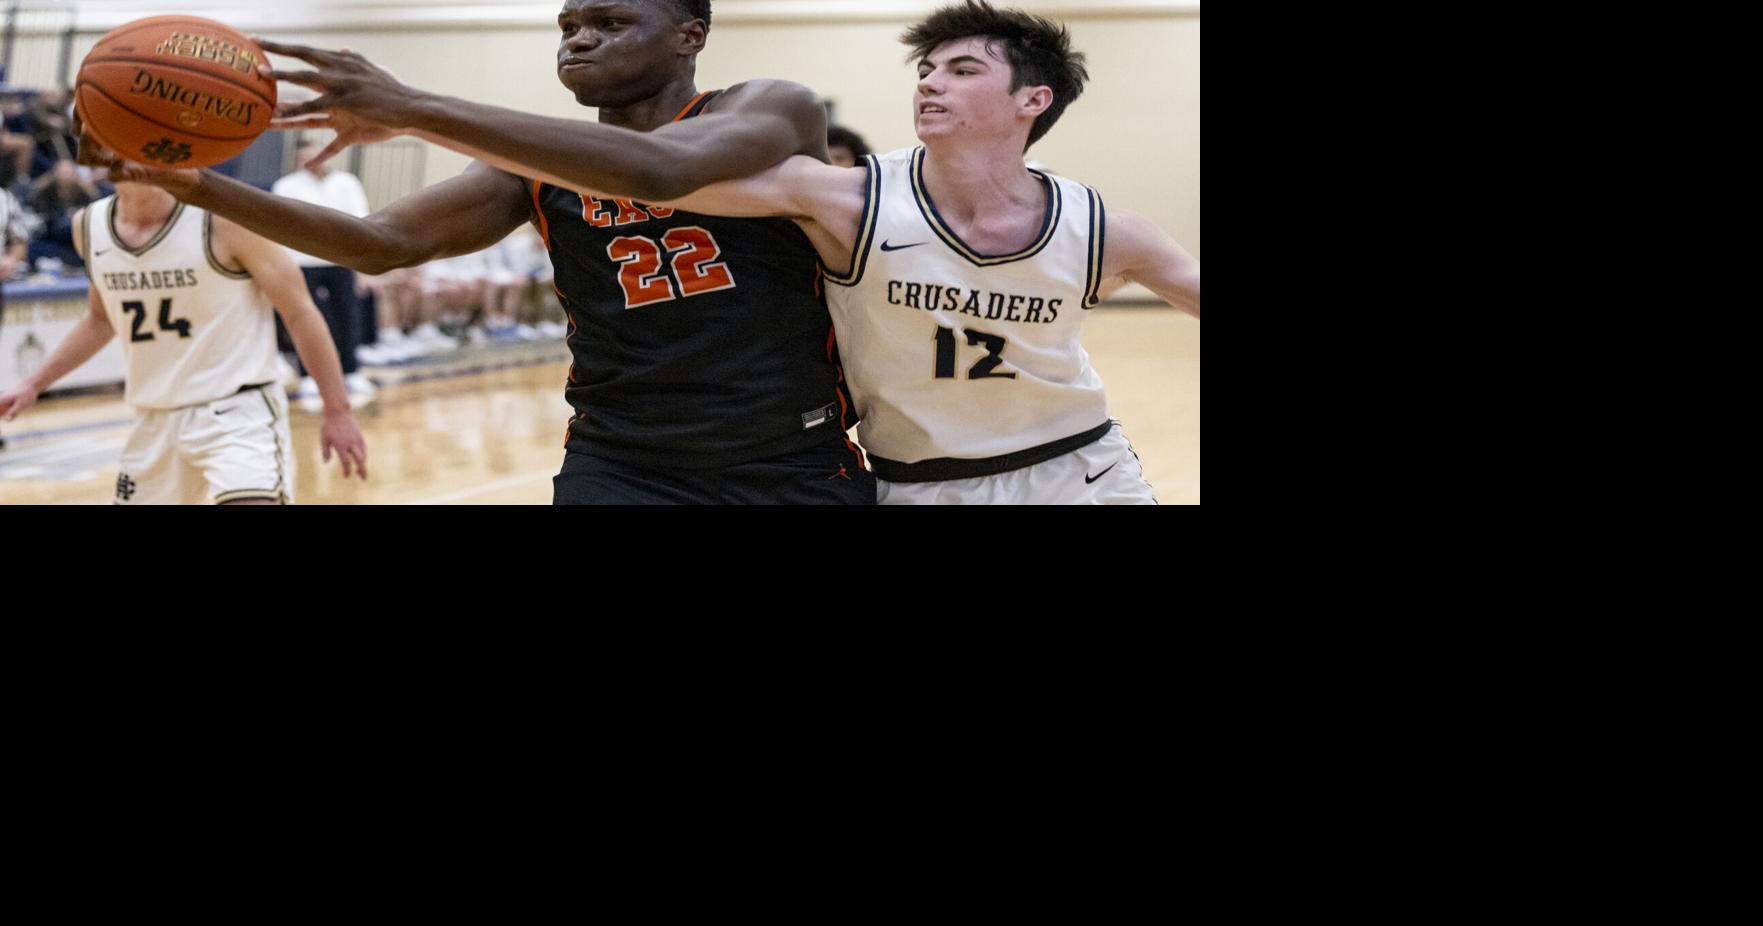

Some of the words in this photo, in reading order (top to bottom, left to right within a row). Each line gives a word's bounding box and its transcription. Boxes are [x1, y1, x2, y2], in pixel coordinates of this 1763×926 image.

[129, 67, 258, 127] SPALDING
[578, 193, 675, 227] EA
[103, 268, 198, 291] CRUSADERS
[606, 225, 736, 310] 22
[121, 297, 191, 343] 24
[887, 279, 1063, 324] CRUSADERS
[931, 323, 1019, 381] 12
